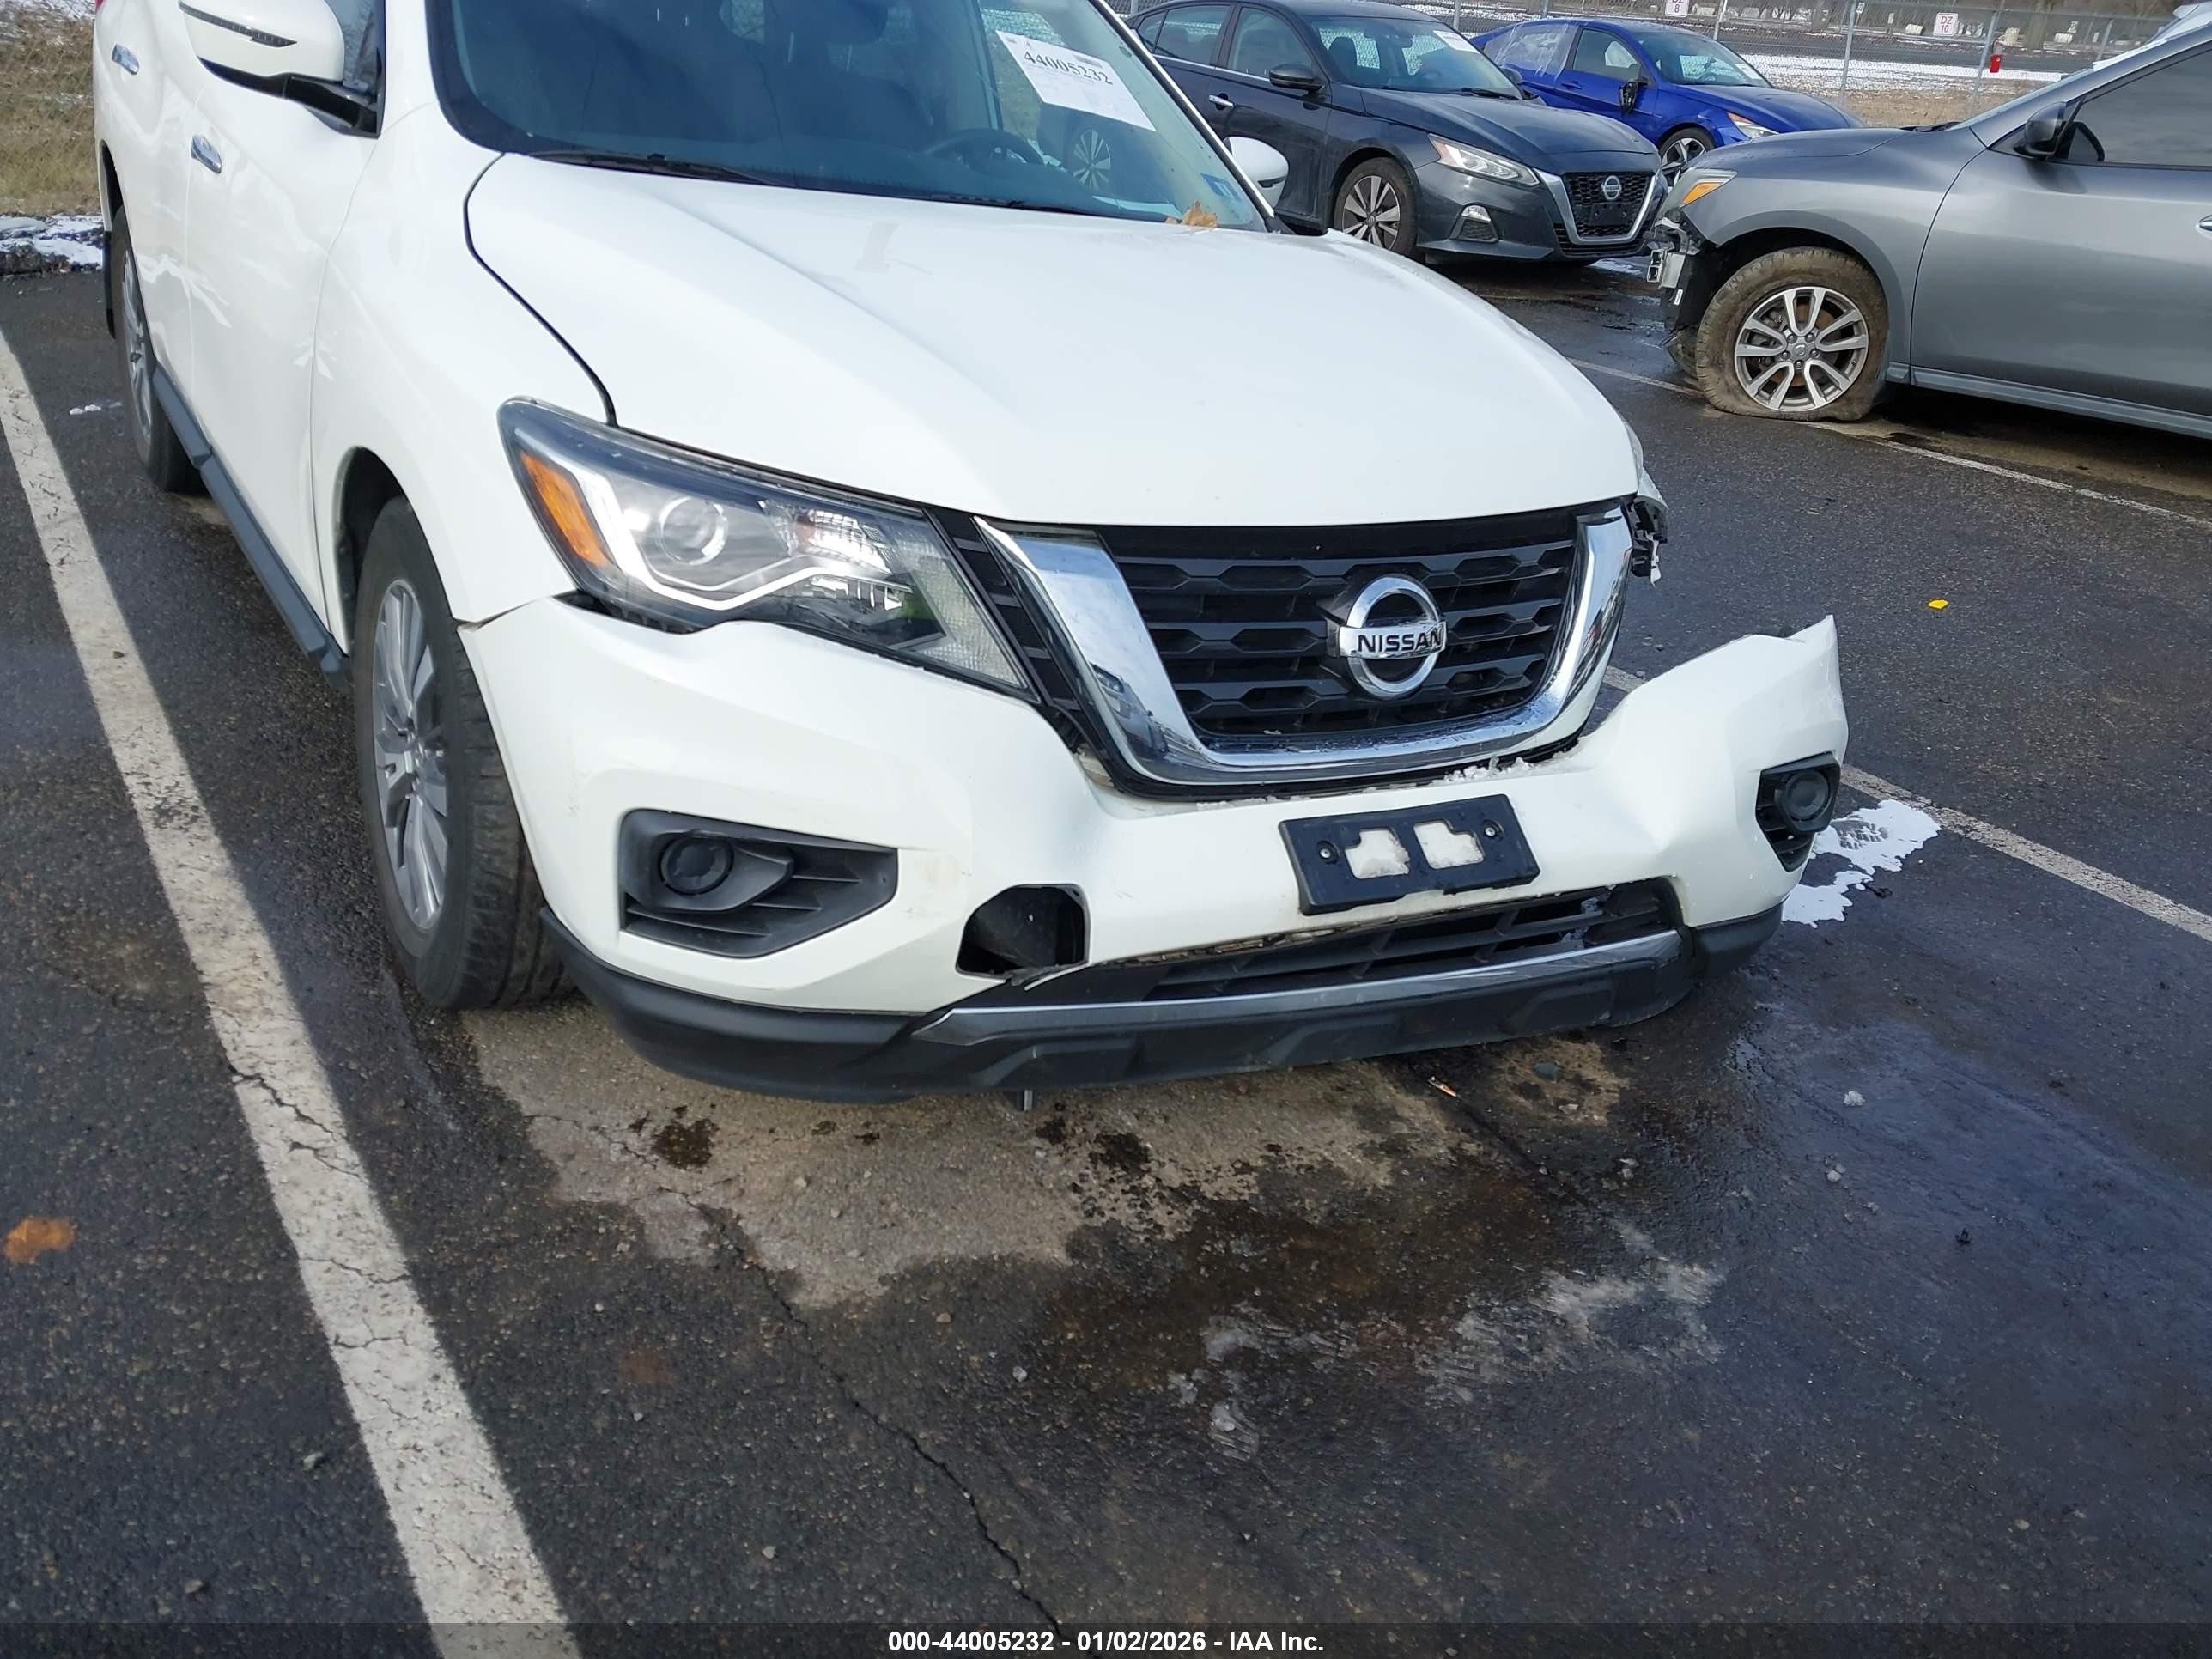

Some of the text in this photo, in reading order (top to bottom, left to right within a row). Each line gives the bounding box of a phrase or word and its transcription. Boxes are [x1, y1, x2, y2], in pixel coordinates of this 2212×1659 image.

[1674, 3, 1680, 14] 8
[1941, 15, 1954, 25] DZ
[1941, 25, 1949, 33] 10
[1024, 52, 1114, 86] 44005232
[1358, 627, 1443, 653] NISSAN
